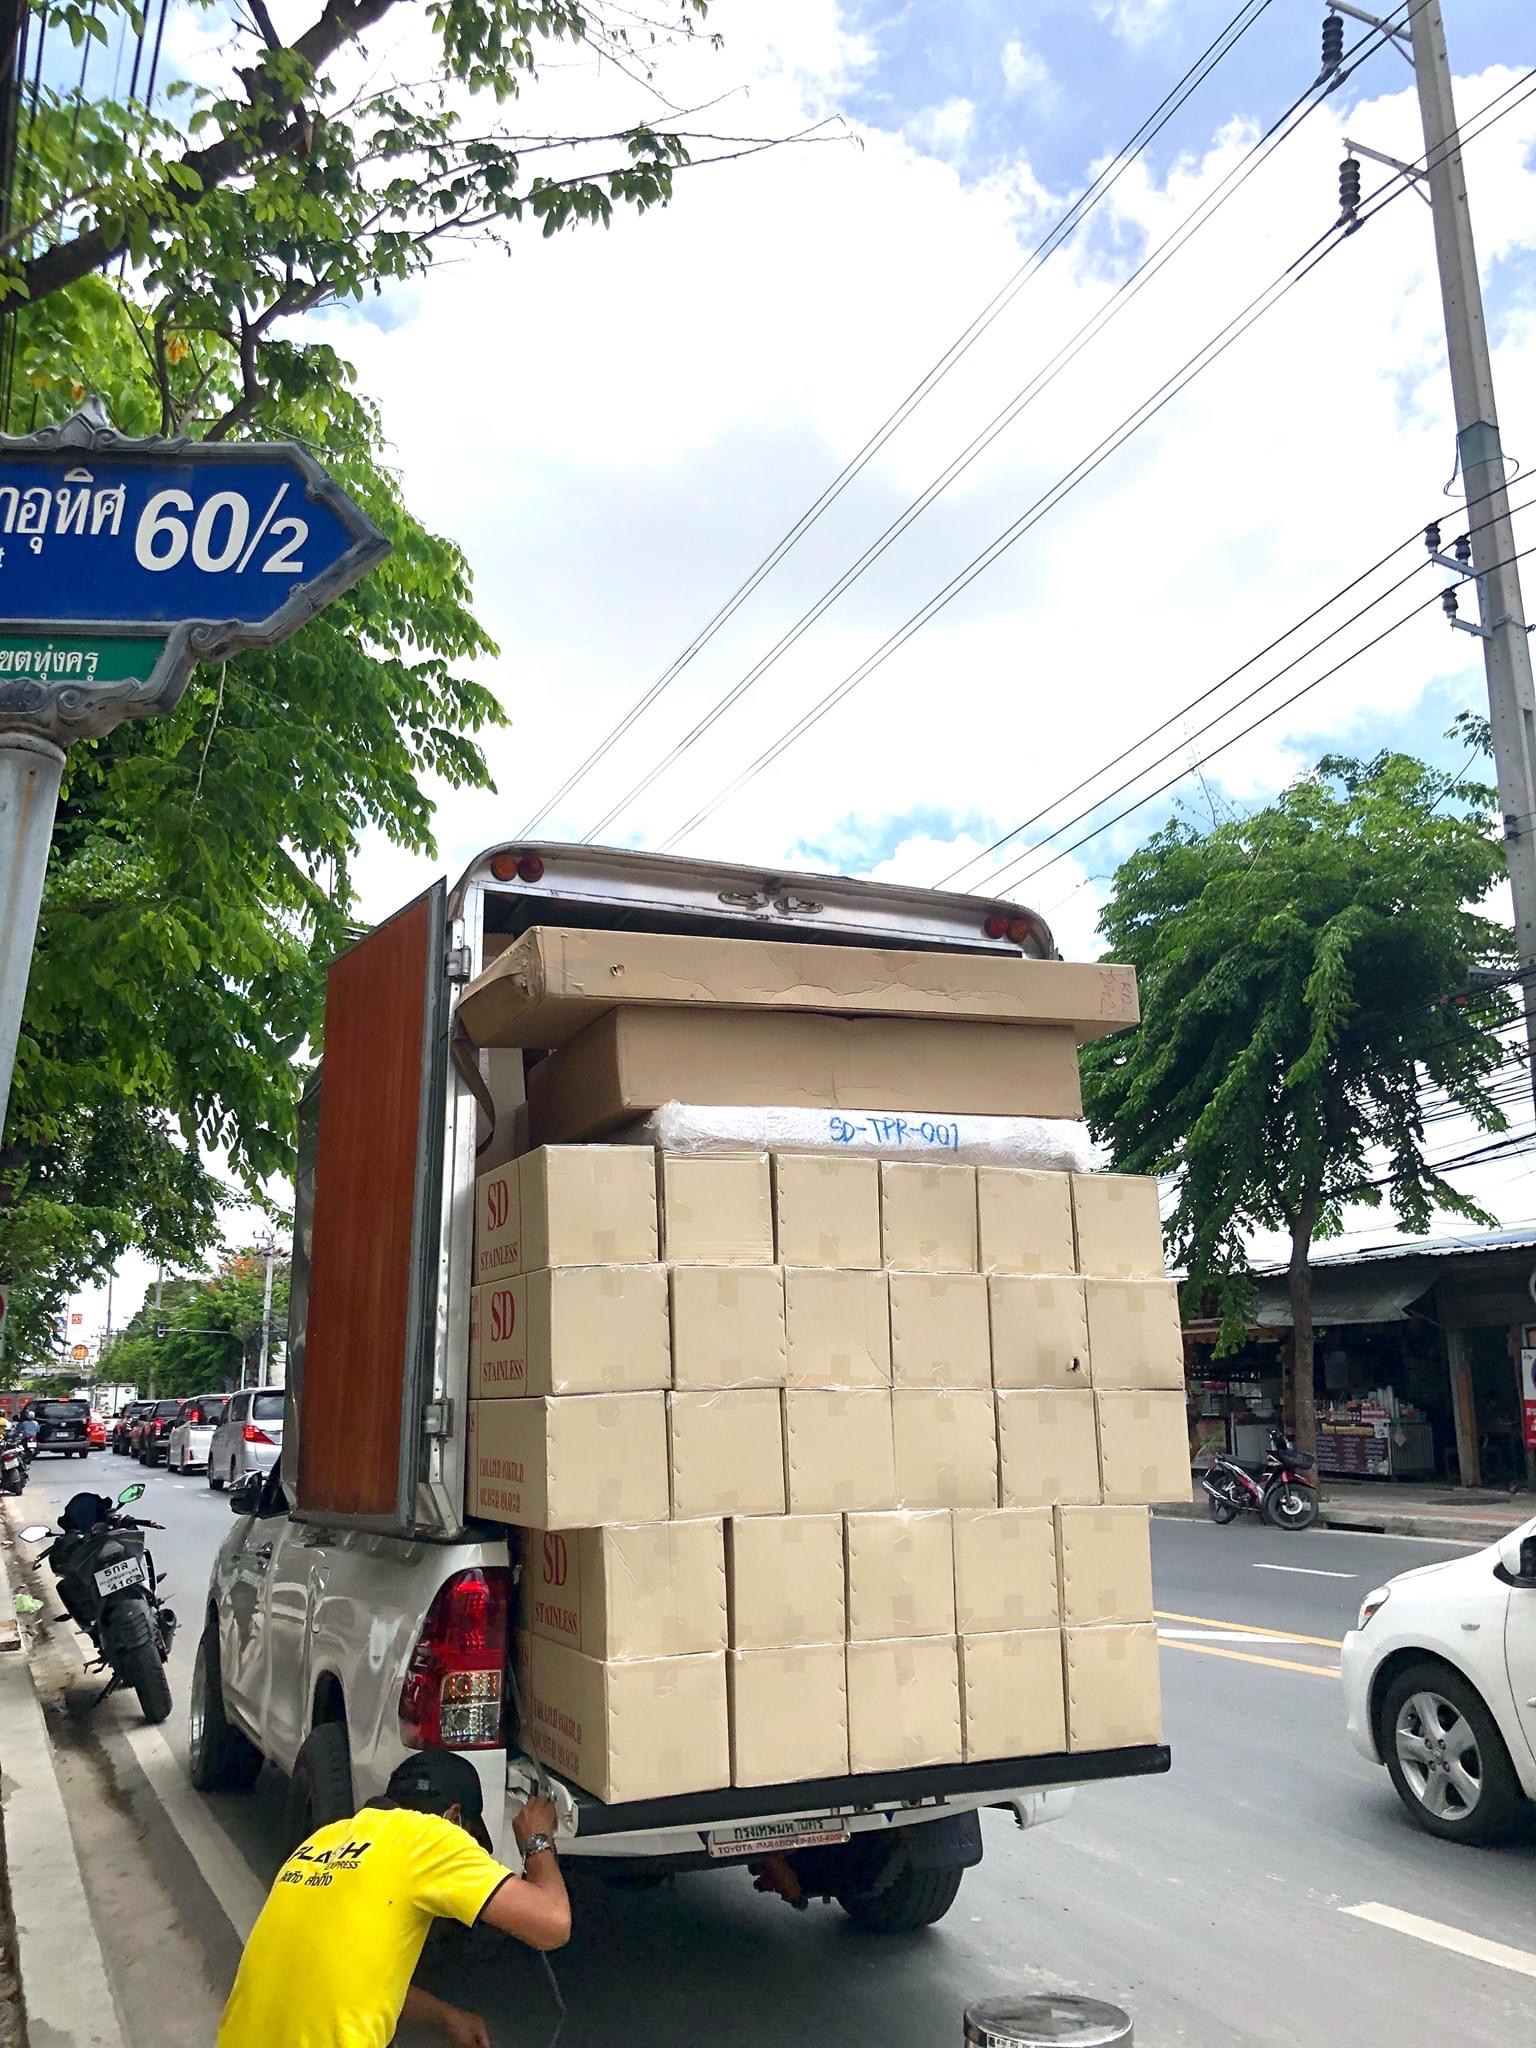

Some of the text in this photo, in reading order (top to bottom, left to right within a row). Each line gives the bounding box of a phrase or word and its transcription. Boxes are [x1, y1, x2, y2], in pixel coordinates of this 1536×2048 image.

[135, 483, 309, 573] 60/2
[829, 1116, 959, 1152] SD-TPR-001
[487, 1180, 508, 1231] SD
[480, 1242, 518, 1271] STAINLESS
[491, 1290, 515, 1342] SD
[482, 1360, 524, 1382] STAINLESS
[543, 1531, 567, 1586] SD
[535, 1601, 578, 1635] STAINLESS
[718, 1844, 753, 1856] TOYOTA
